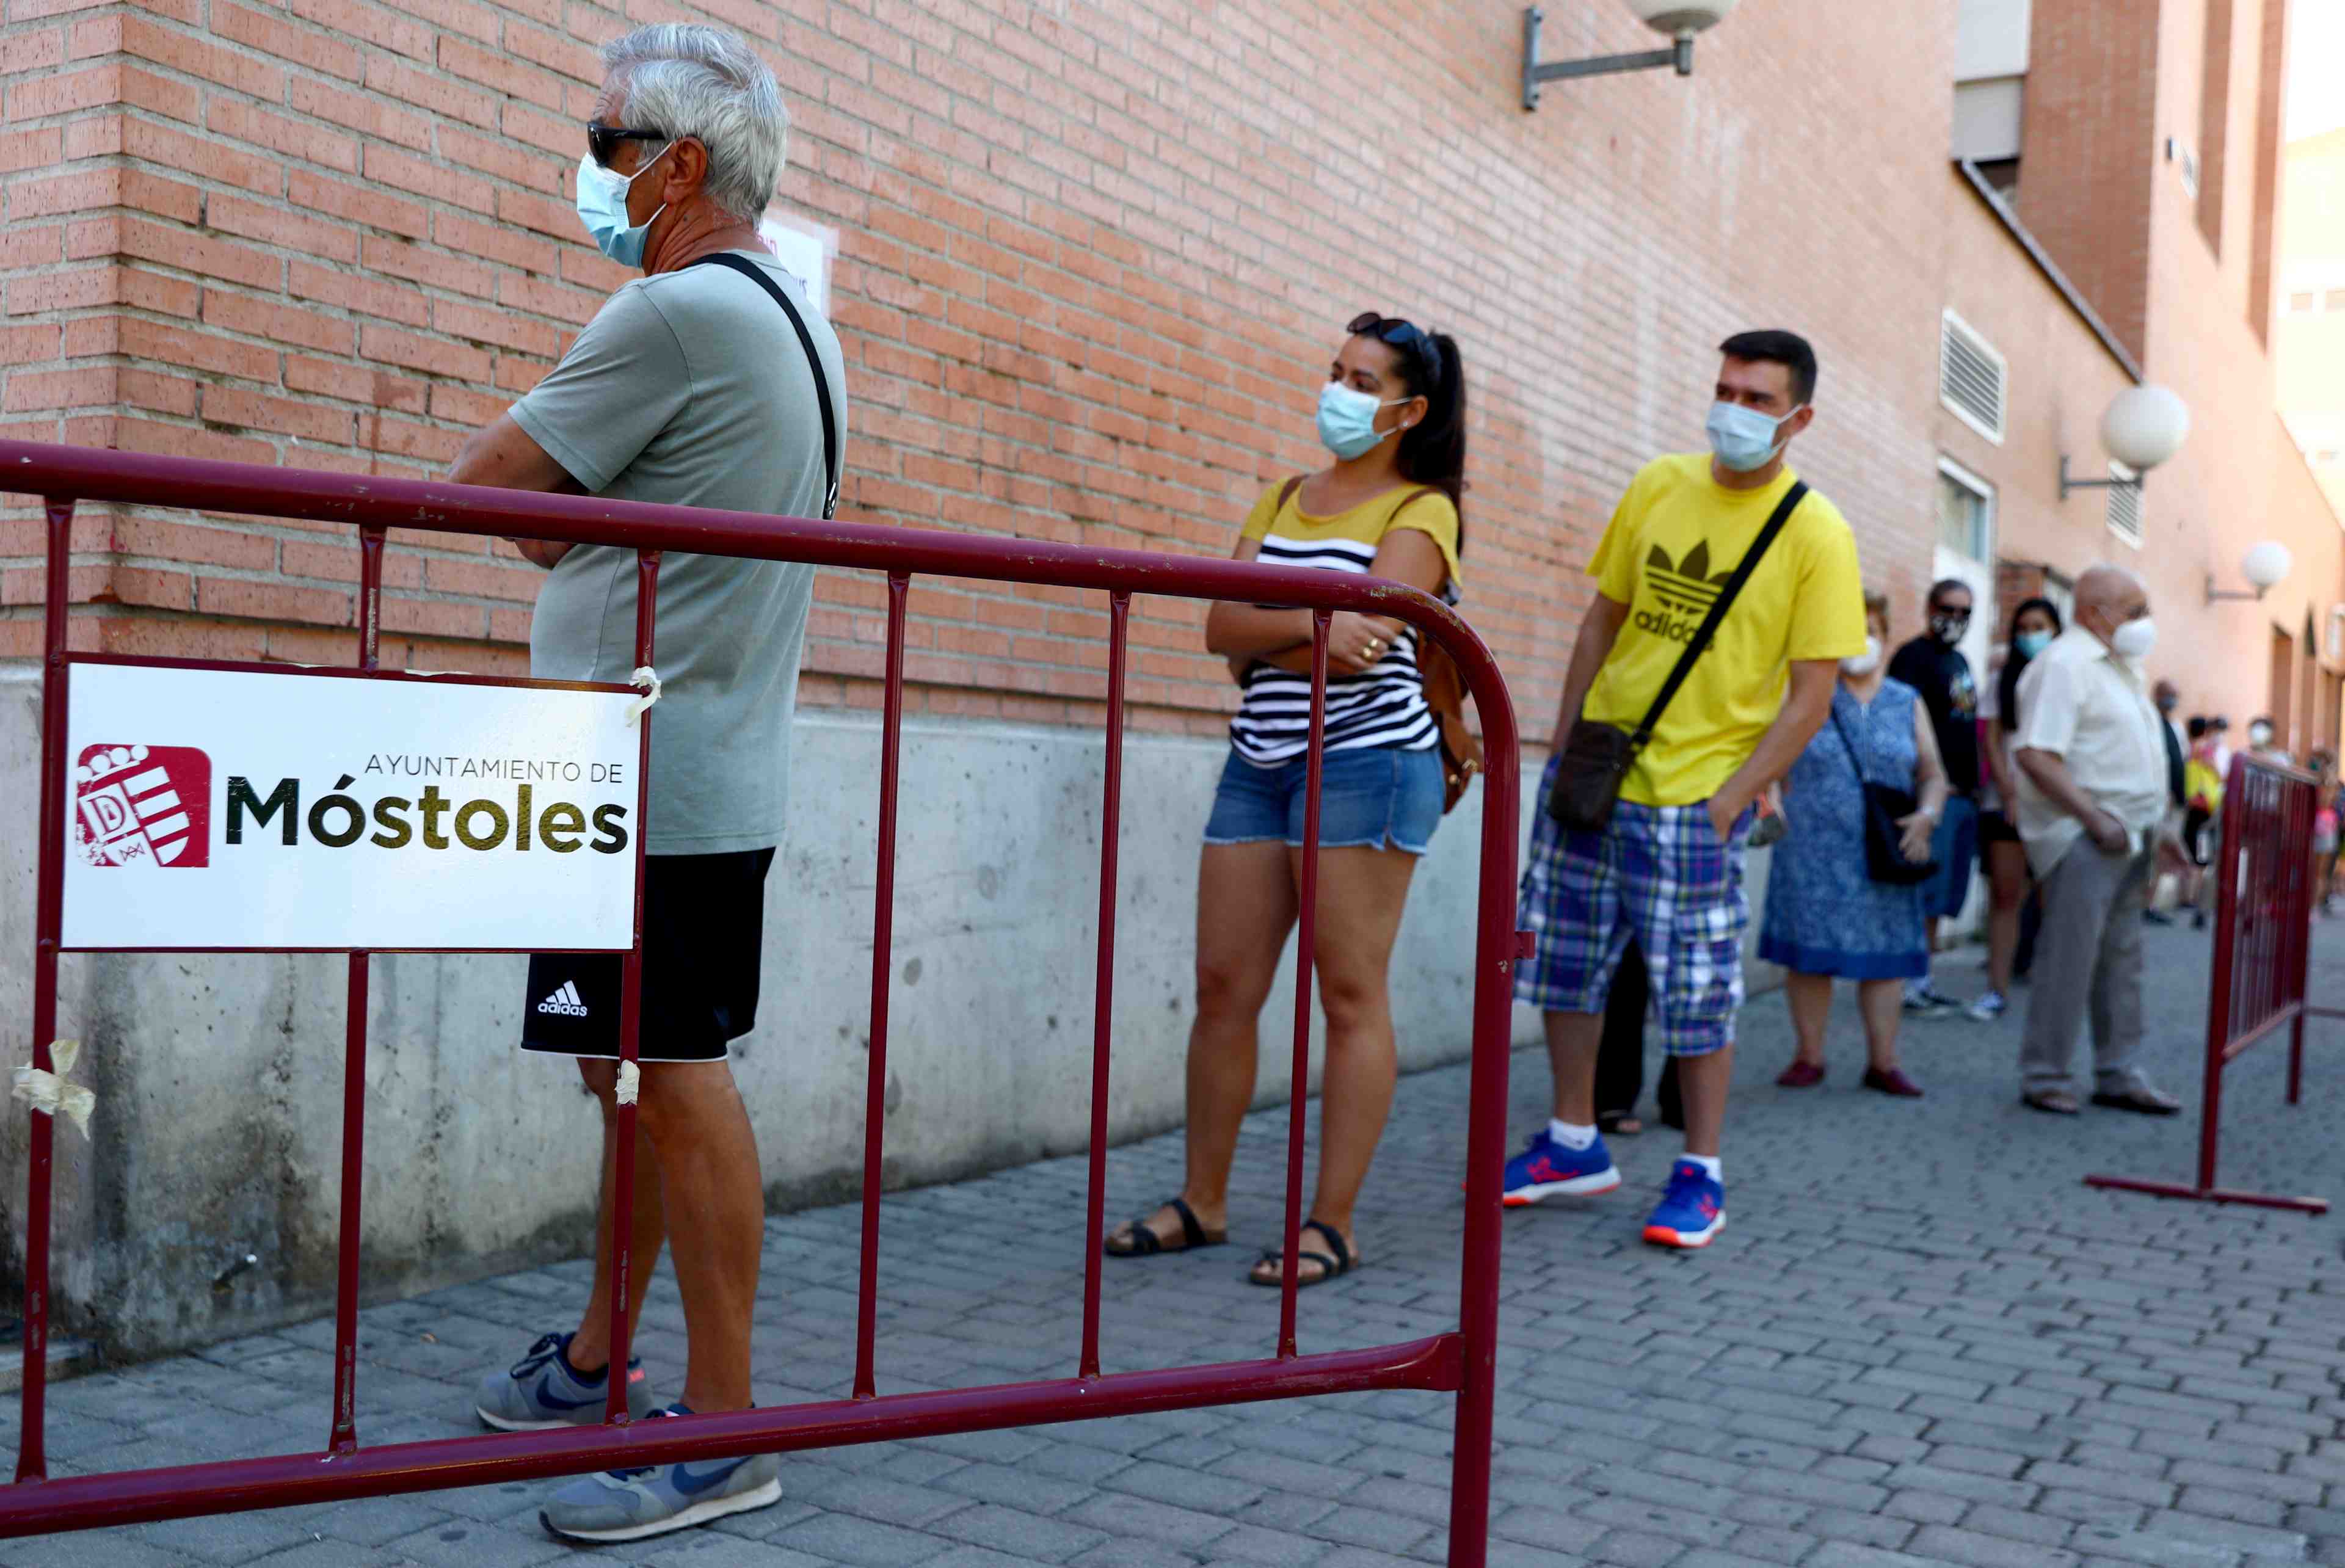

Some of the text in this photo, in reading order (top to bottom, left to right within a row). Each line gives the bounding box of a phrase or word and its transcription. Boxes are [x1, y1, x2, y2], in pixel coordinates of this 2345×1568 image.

[1635, 611, 1714, 652] adida
[365, 754, 623, 783] AYUNTAMIENTO DE
[225, 774, 628, 854] Móstoles
[538, 1002, 587, 1017] adidas
